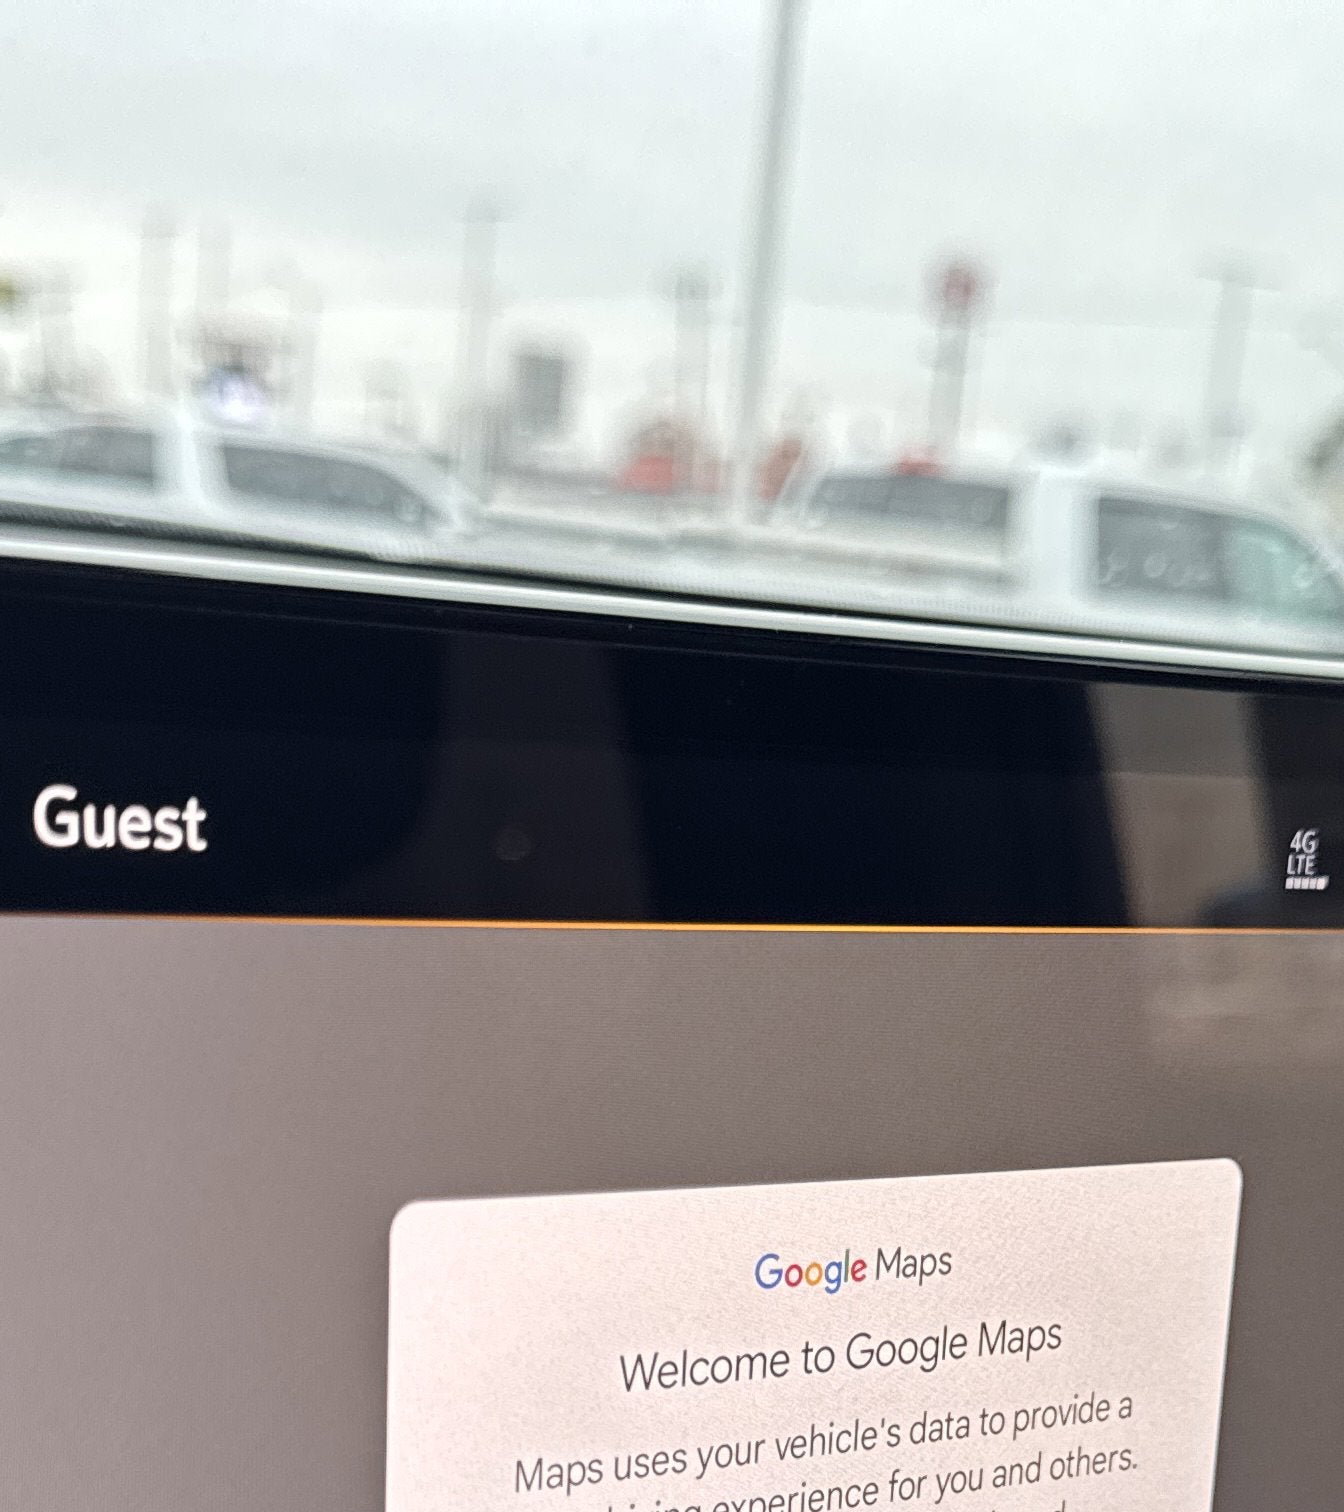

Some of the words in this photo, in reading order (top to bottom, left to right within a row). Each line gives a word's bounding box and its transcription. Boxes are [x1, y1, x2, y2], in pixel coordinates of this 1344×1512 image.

[32, 783, 209, 853] Guest
[1289, 828, 1319, 854] 4G
[1285, 854, 1317, 877] LTE
[754, 1248, 868, 1295] Google
[875, 1246, 953, 1287] Maps
[619, 1348, 791, 1393] Welcome
[800, 1340, 836, 1375] to
[846, 1324, 969, 1374] Google
[978, 1319, 1062, 1363] Maps
[515, 1457, 604, 1497] Maps
[614, 1448, 688, 1482] uses
[695, 1438, 767, 1481] your
[774, 1416, 901, 1461] vehicle's
[909, 1410, 970, 1446] data
[978, 1407, 1006, 1437] to
[1012, 1390, 1111, 1442] provide
[1118, 1396, 1133, 1420] a
[888, 1468, 929, 1504] for
[934, 1467, 984, 1505] you
[992, 1450, 1043, 1489] and
[1049, 1445, 1139, 1482] others.
